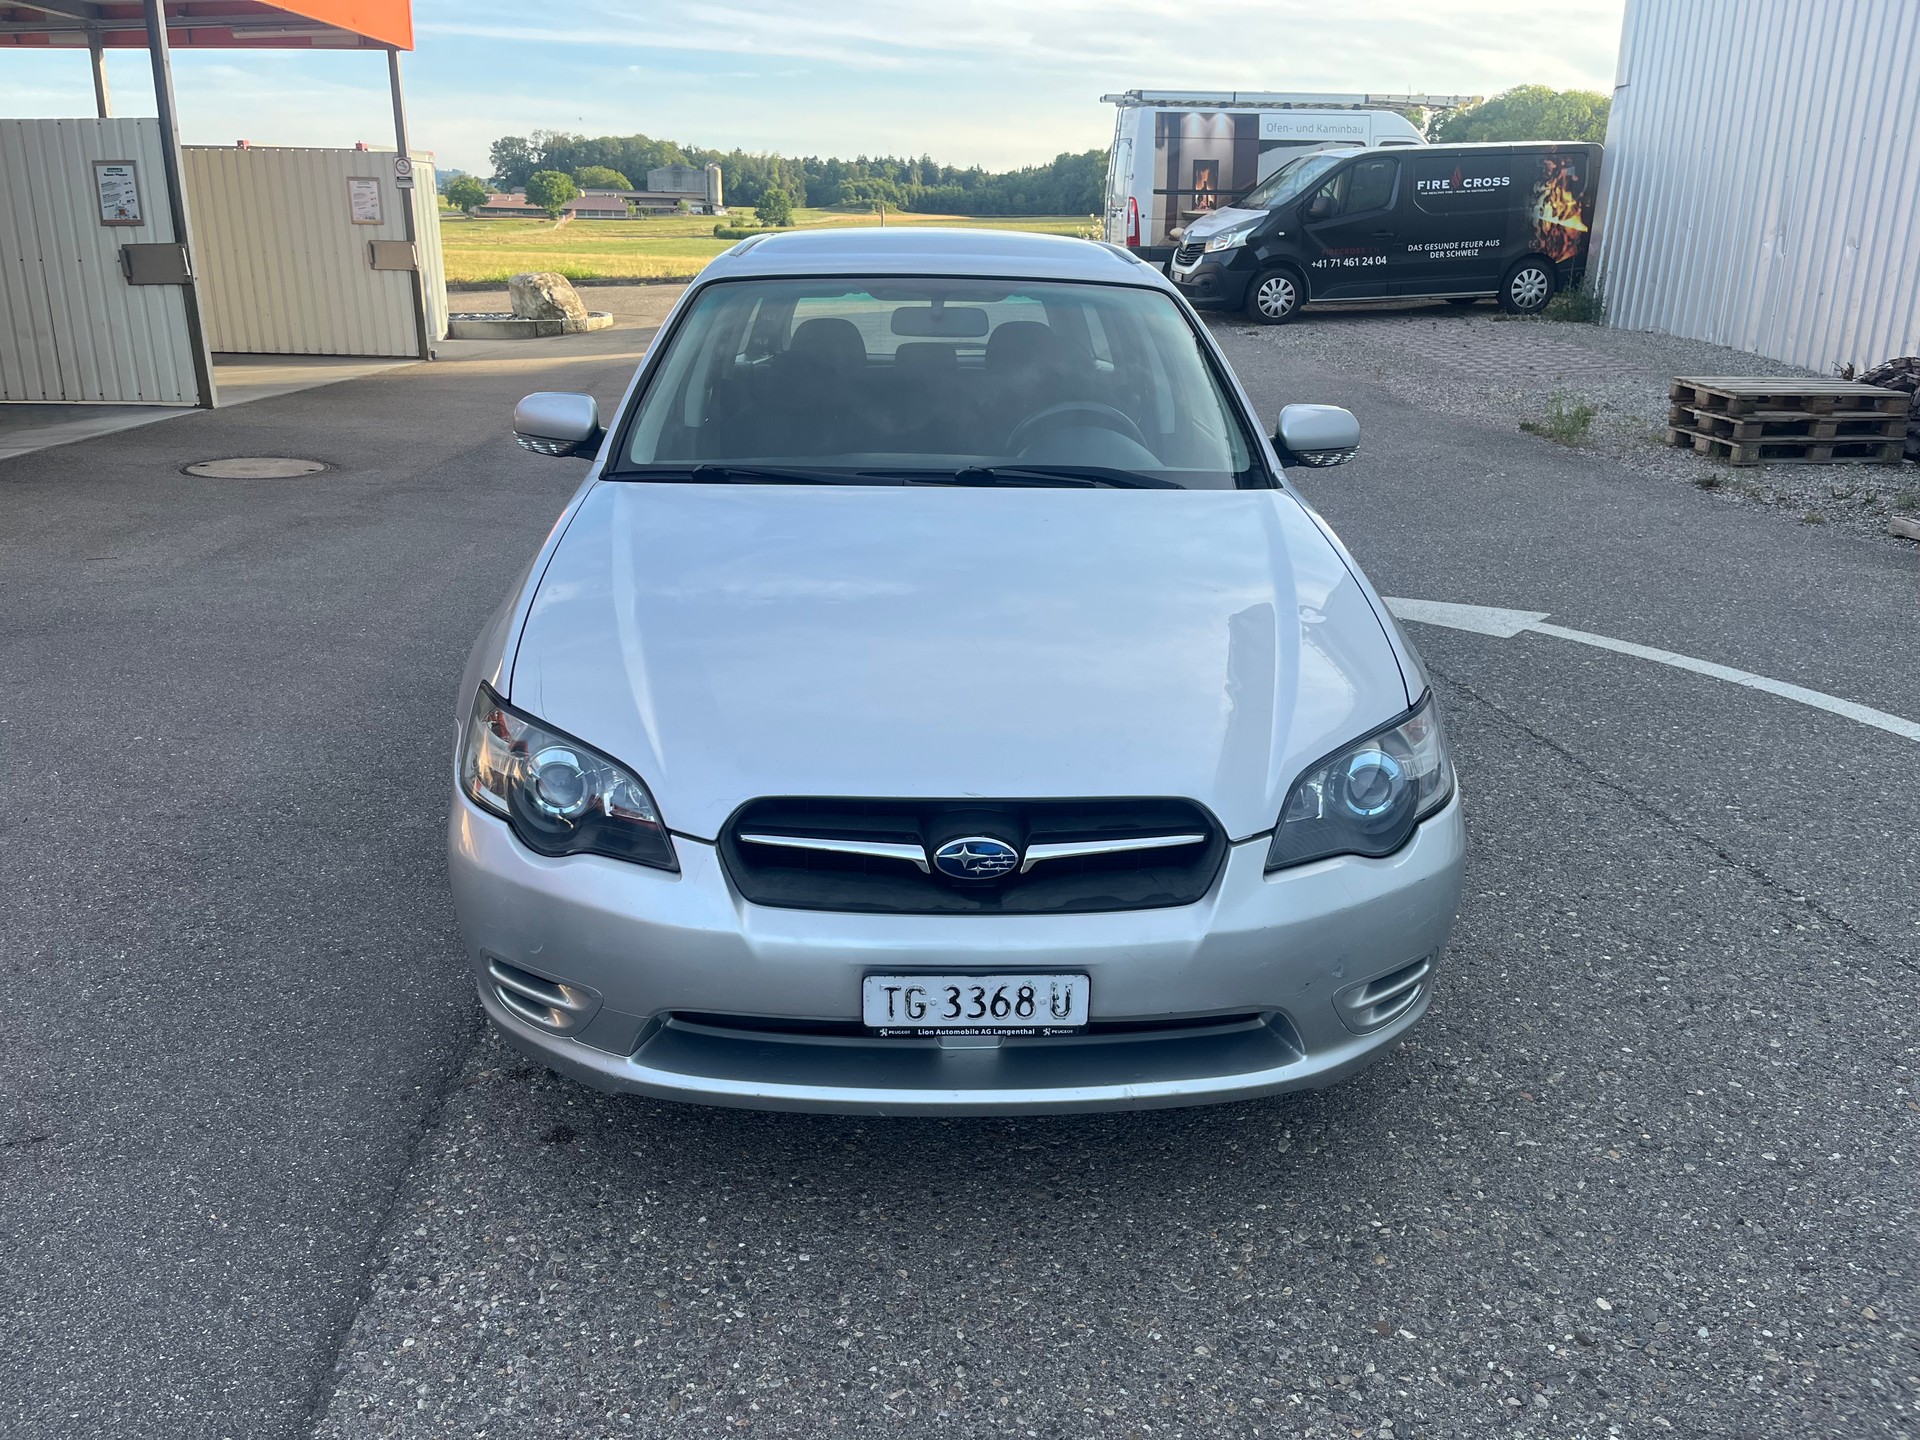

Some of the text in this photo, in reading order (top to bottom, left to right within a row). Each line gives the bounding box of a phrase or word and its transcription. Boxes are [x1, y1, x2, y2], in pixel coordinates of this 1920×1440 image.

[1266, 123, 1364, 134] Ofen- und Kaminbau
[1417, 176, 1510, 190] FIRE CROSS
[1424, 242, 1459, 251] GESUNDE
[1461, 240, 1483, 248] FEUER
[1446, 249, 1478, 257] SCHWEIZ
[1311, 256, 1387, 268] +41 71 461 24 04
[880, 980, 1073, 1021] TG 3368 U
